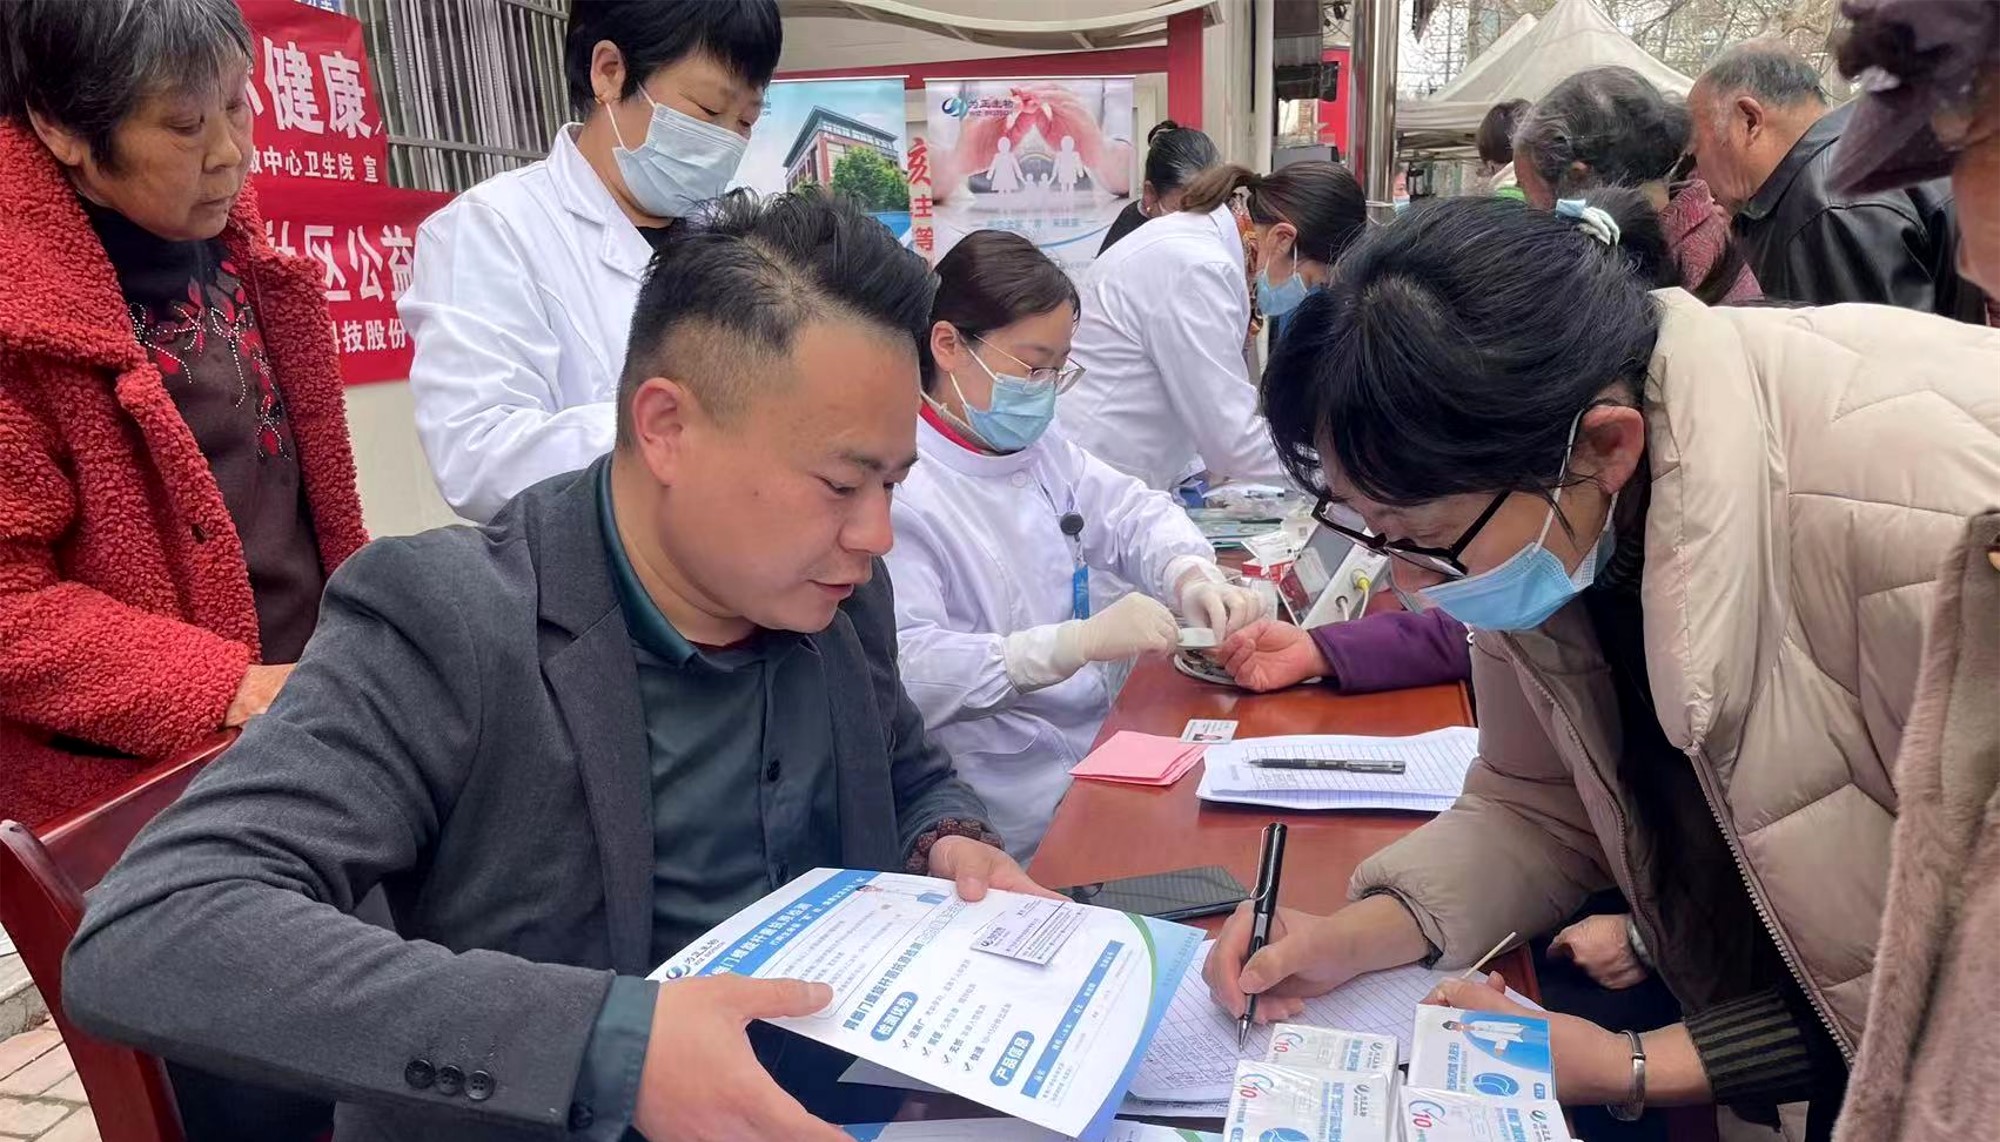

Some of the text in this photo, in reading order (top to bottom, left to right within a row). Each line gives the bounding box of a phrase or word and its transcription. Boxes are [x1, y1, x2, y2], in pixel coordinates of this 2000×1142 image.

[246, 36, 383, 139] 健康
[363, 155, 379, 183] 宣
[1273, 1040, 1289, 1054] 10
[995, 1036, 1031, 1081] 产品信息
[1239, 1084, 1259, 1099] 10
[1412, 1114, 1433, 1129] 10
